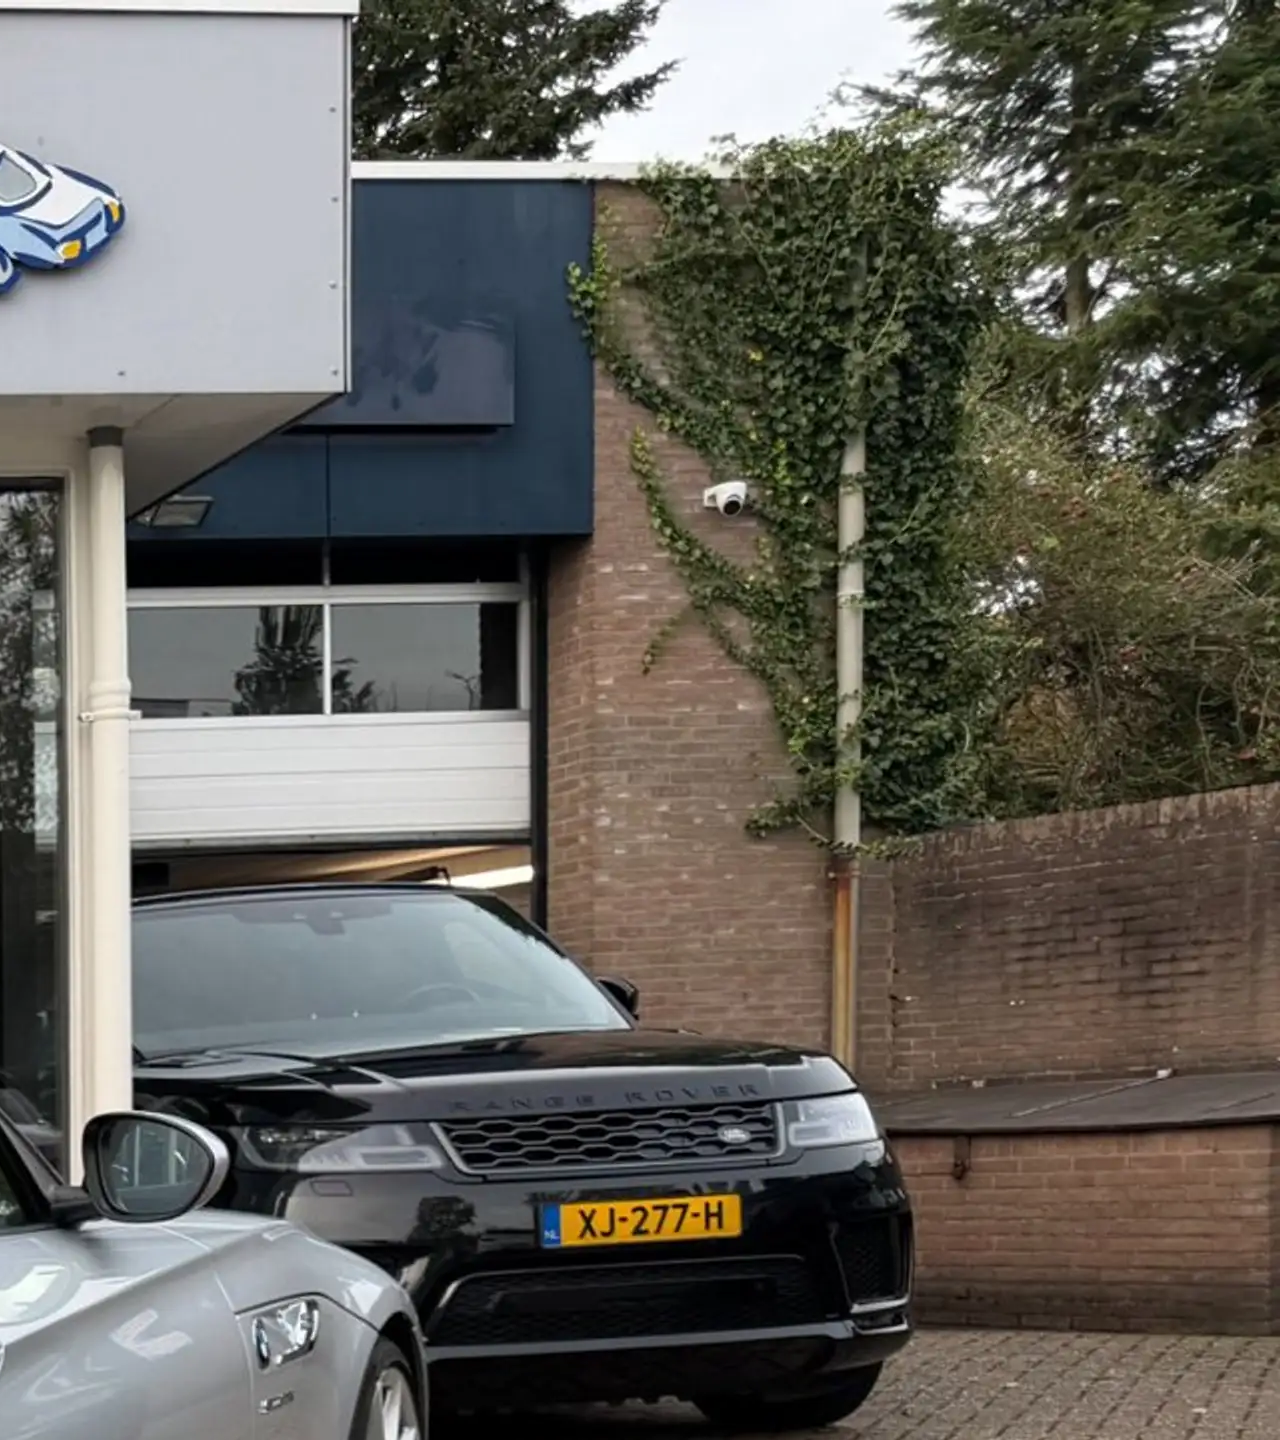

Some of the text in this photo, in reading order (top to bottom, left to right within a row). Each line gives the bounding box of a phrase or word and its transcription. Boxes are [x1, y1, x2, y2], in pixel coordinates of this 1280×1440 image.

[450, 1083, 759, 1113] RANGE ROVER
[578, 1200, 724, 1240] XJ-277-H
